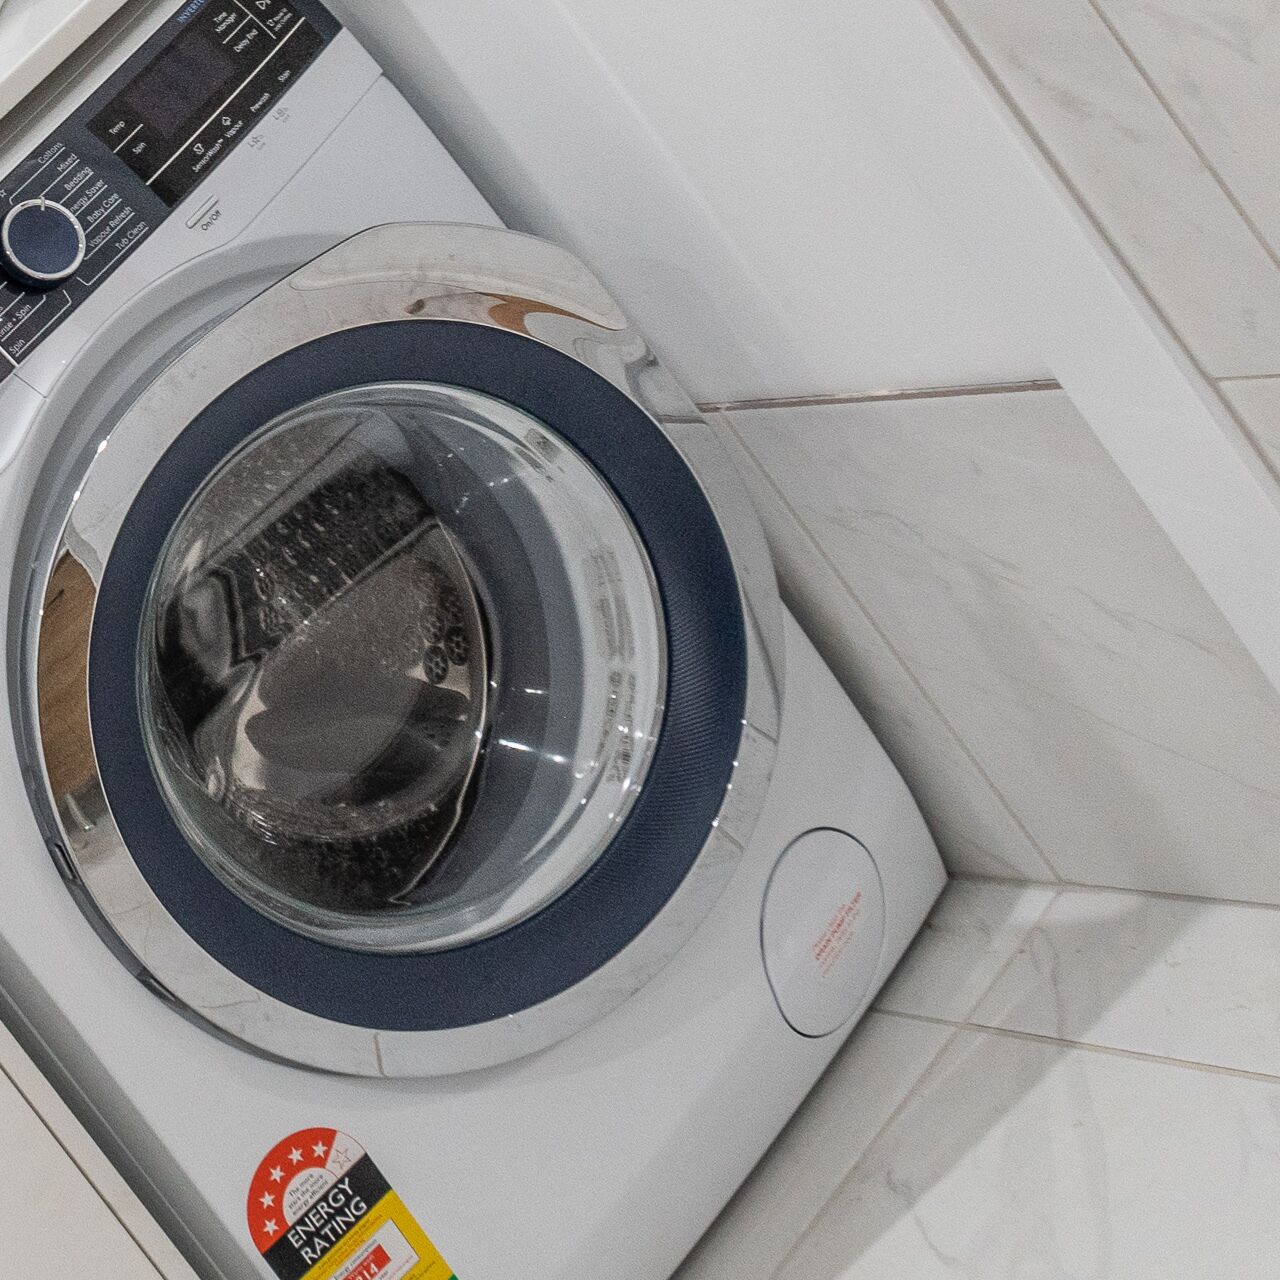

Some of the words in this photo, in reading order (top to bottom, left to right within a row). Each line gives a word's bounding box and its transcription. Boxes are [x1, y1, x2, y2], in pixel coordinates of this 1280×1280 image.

[232, 36, 250, 53] Delay
[245, 27, 258, 40] End
[108, 118, 126, 136] Temp
[38, 140, 62, 164] Cottons
[131, 139, 147, 155] Spin
[56, 152, 77, 172] Mixed
[65, 165, 91, 191] Bedding
[69, 195, 88, 214] nergy
[85, 177, 105, 197] Saver
[87, 205, 105, 224] Baby
[102, 191, 119, 208] Care
[87, 224, 112, 249] Vapour
[109, 205, 132, 228] Refresh
[199, 209, 222, 232] On/Off
[115, 236, 128, 250] Tub
[126, 220, 146, 239] Clean
[15, 302, 32, 319] Spin
[8, 337, 26, 354] Spin
[288, 1176, 355, 1248] ENERGY
[302, 1195, 366, 1264] RATING
